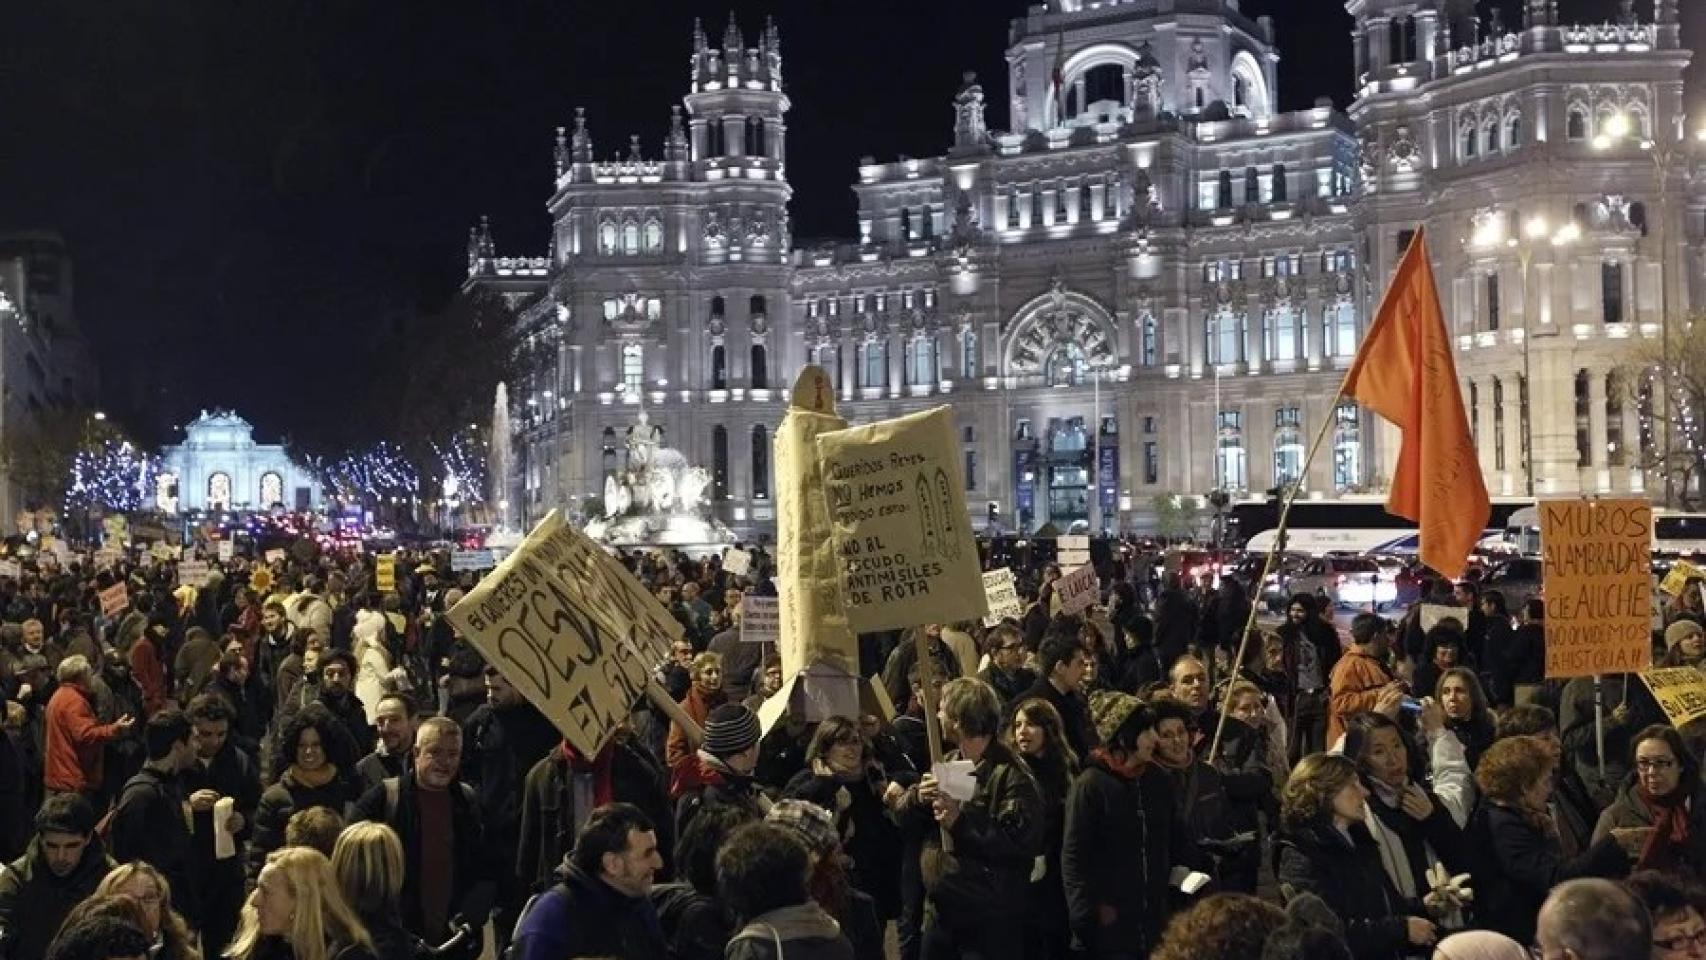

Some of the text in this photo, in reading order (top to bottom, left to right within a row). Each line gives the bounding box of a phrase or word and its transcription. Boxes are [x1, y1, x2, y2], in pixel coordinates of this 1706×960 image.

[1547, 506, 1650, 538] MUROS
[843, 539, 860, 555] NO
[847, 554, 905, 572] ESCUDO
[1544, 542, 1650, 578] ALAMBRADAS
[852, 580, 930, 605] DE ROTA
